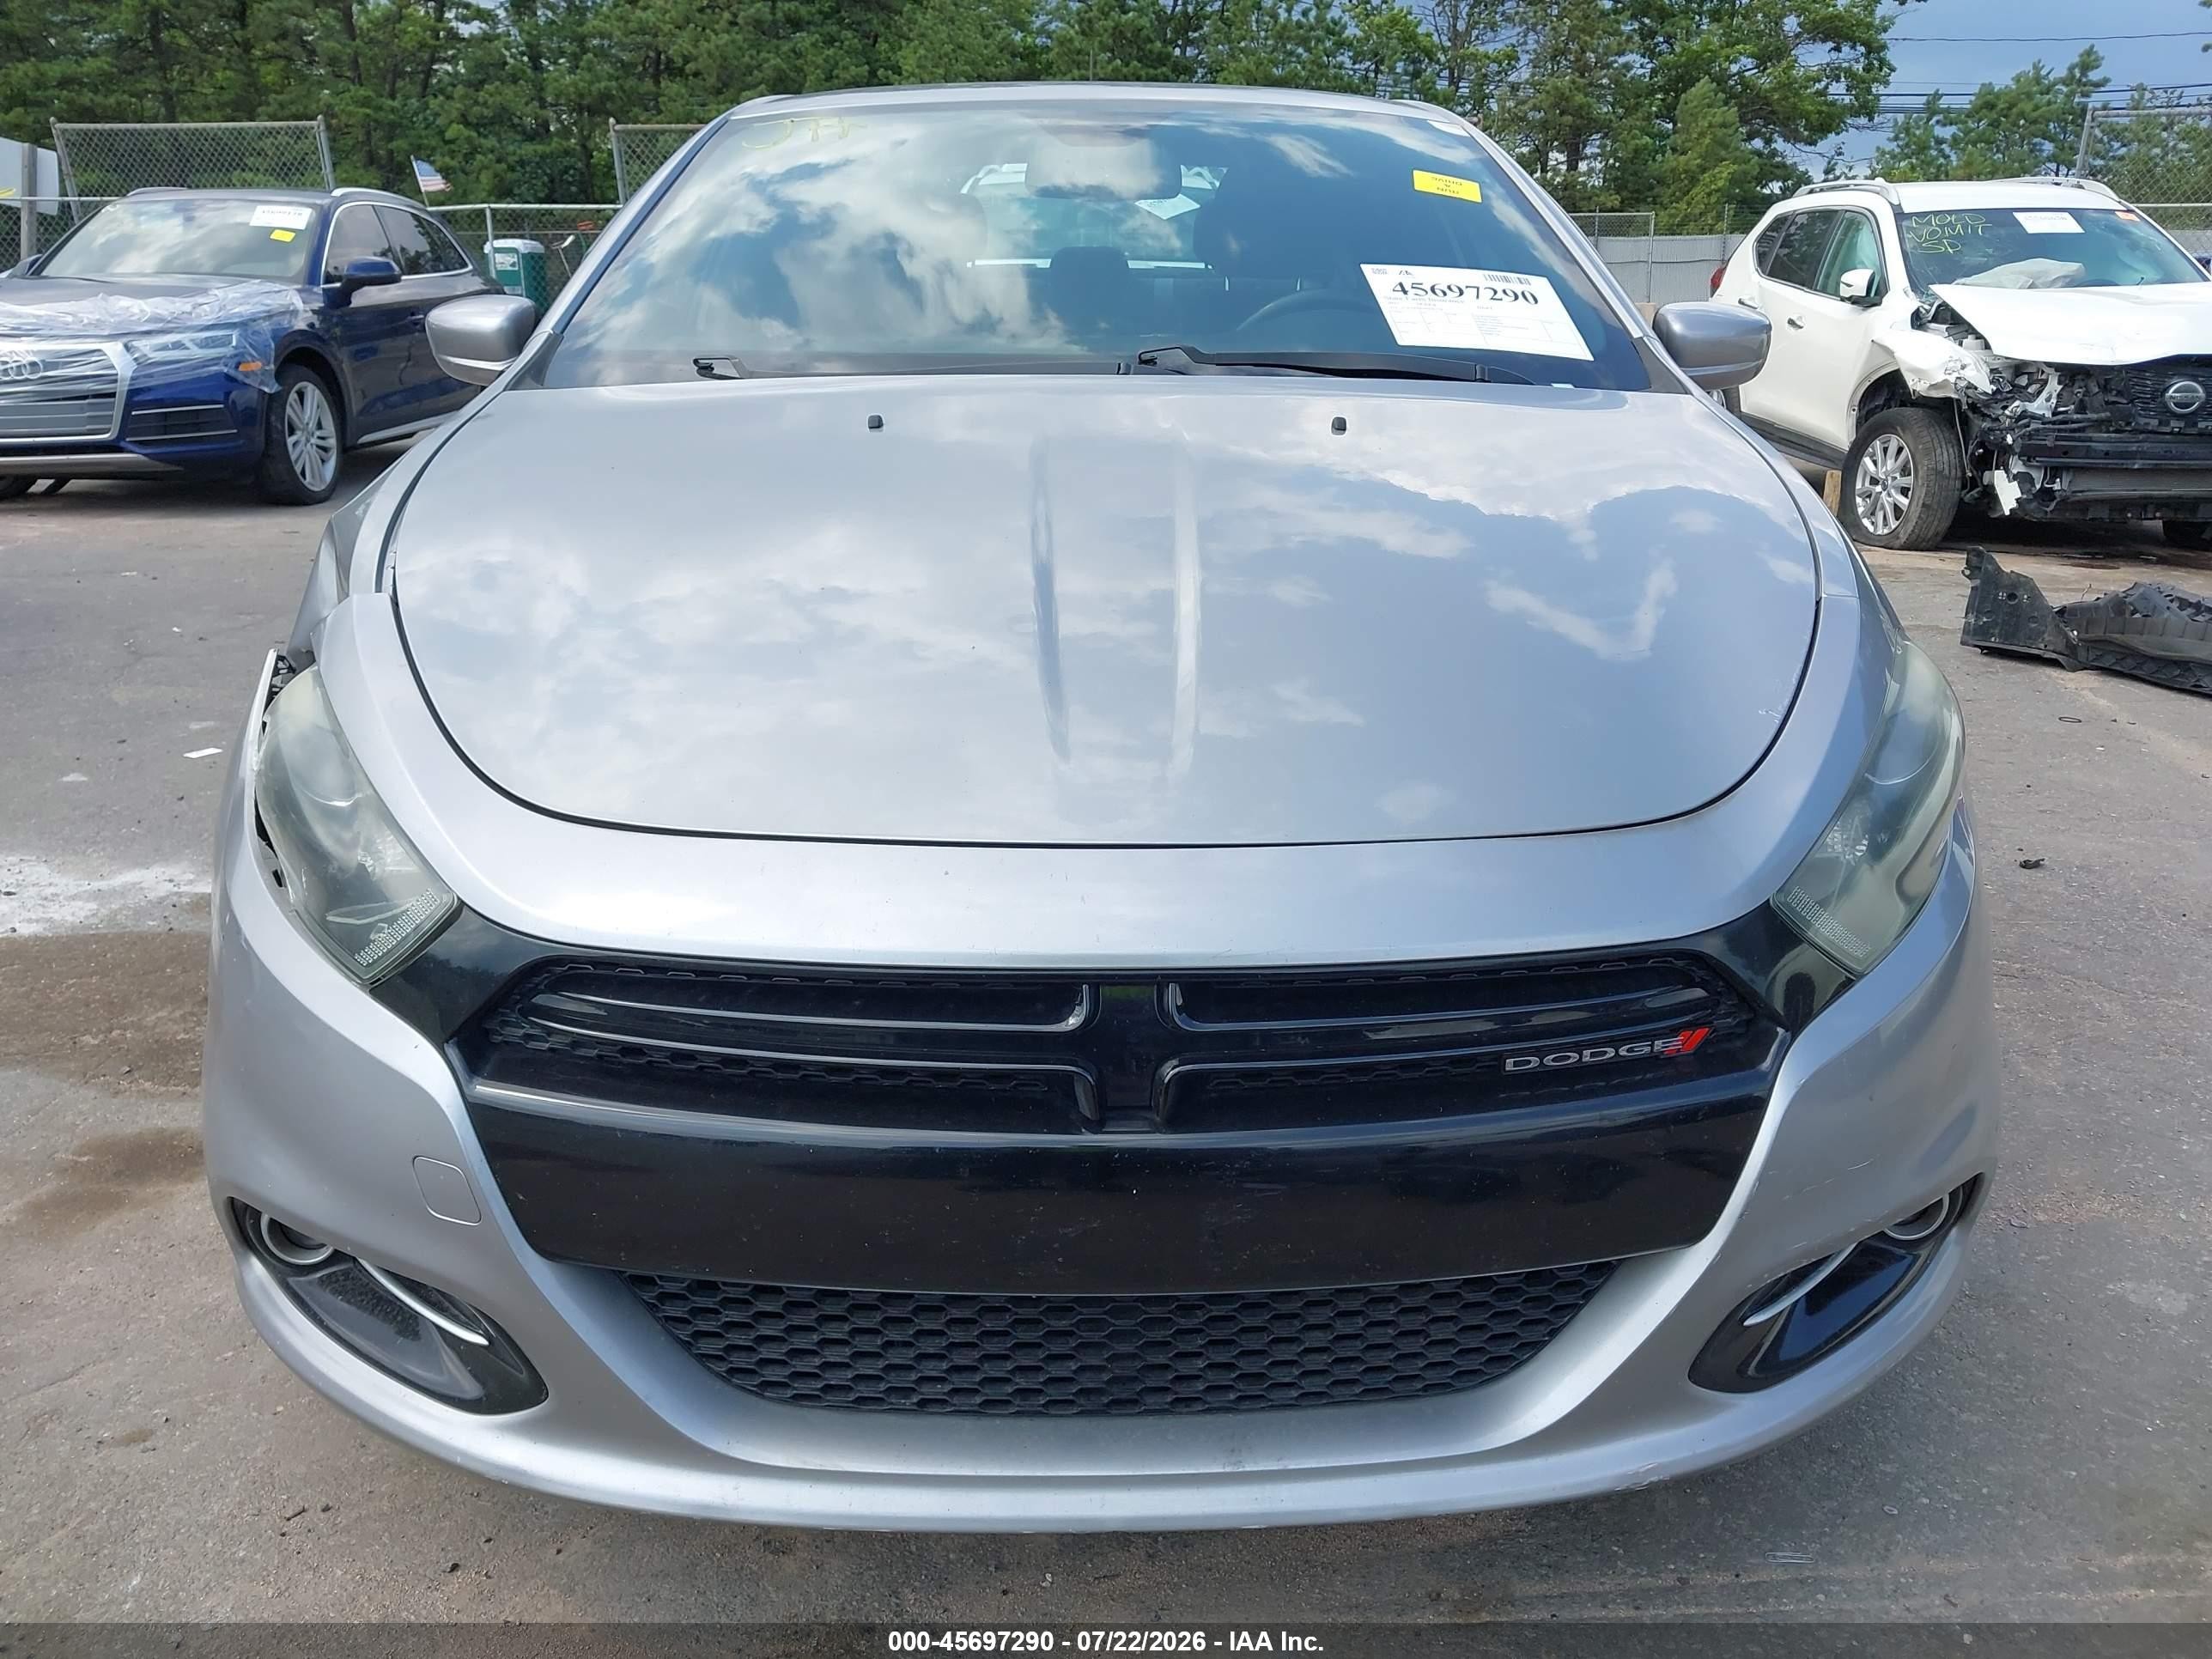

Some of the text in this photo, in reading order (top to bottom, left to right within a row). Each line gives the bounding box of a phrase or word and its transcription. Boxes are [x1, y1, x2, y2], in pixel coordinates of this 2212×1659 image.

[1911, 213, 1986, 228] MOLD
[1909, 223, 1993, 242] VOMIT
[1391, 281, 1539, 306] 45697290
[1504, 1036, 1684, 1072] DODGE
